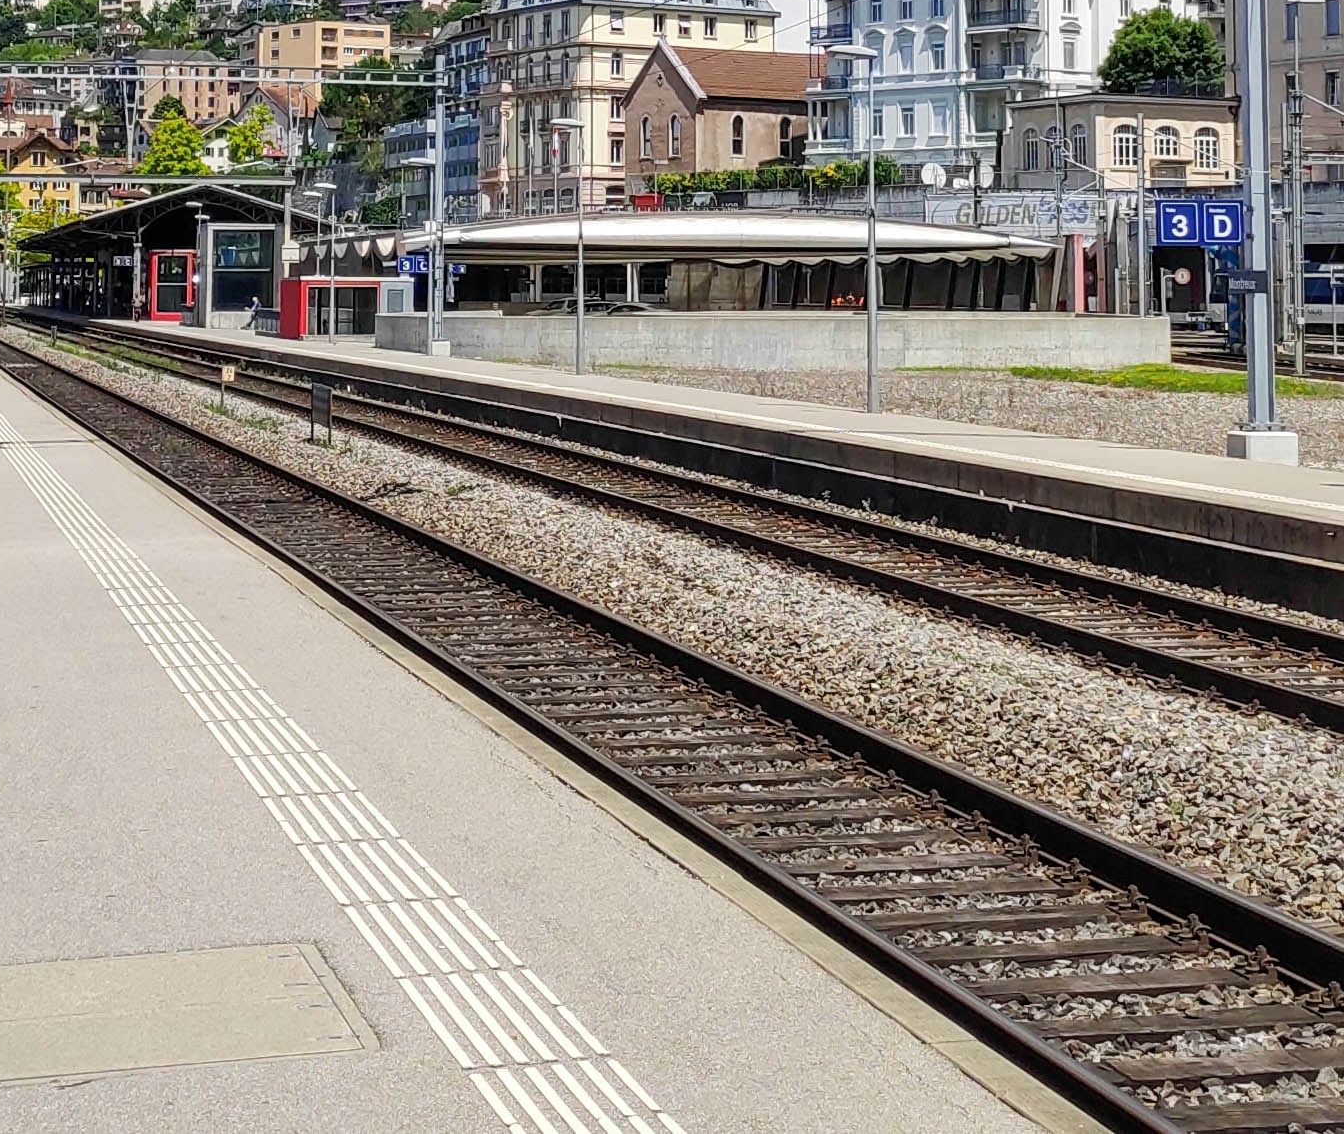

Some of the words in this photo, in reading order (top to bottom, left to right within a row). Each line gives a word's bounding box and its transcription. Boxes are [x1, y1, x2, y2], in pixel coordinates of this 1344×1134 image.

[1171, 214, 1188, 237] 3
[1213, 214, 1232, 238] D
[402, 260, 410, 271] 3
[419, 260, 428, 271] C
